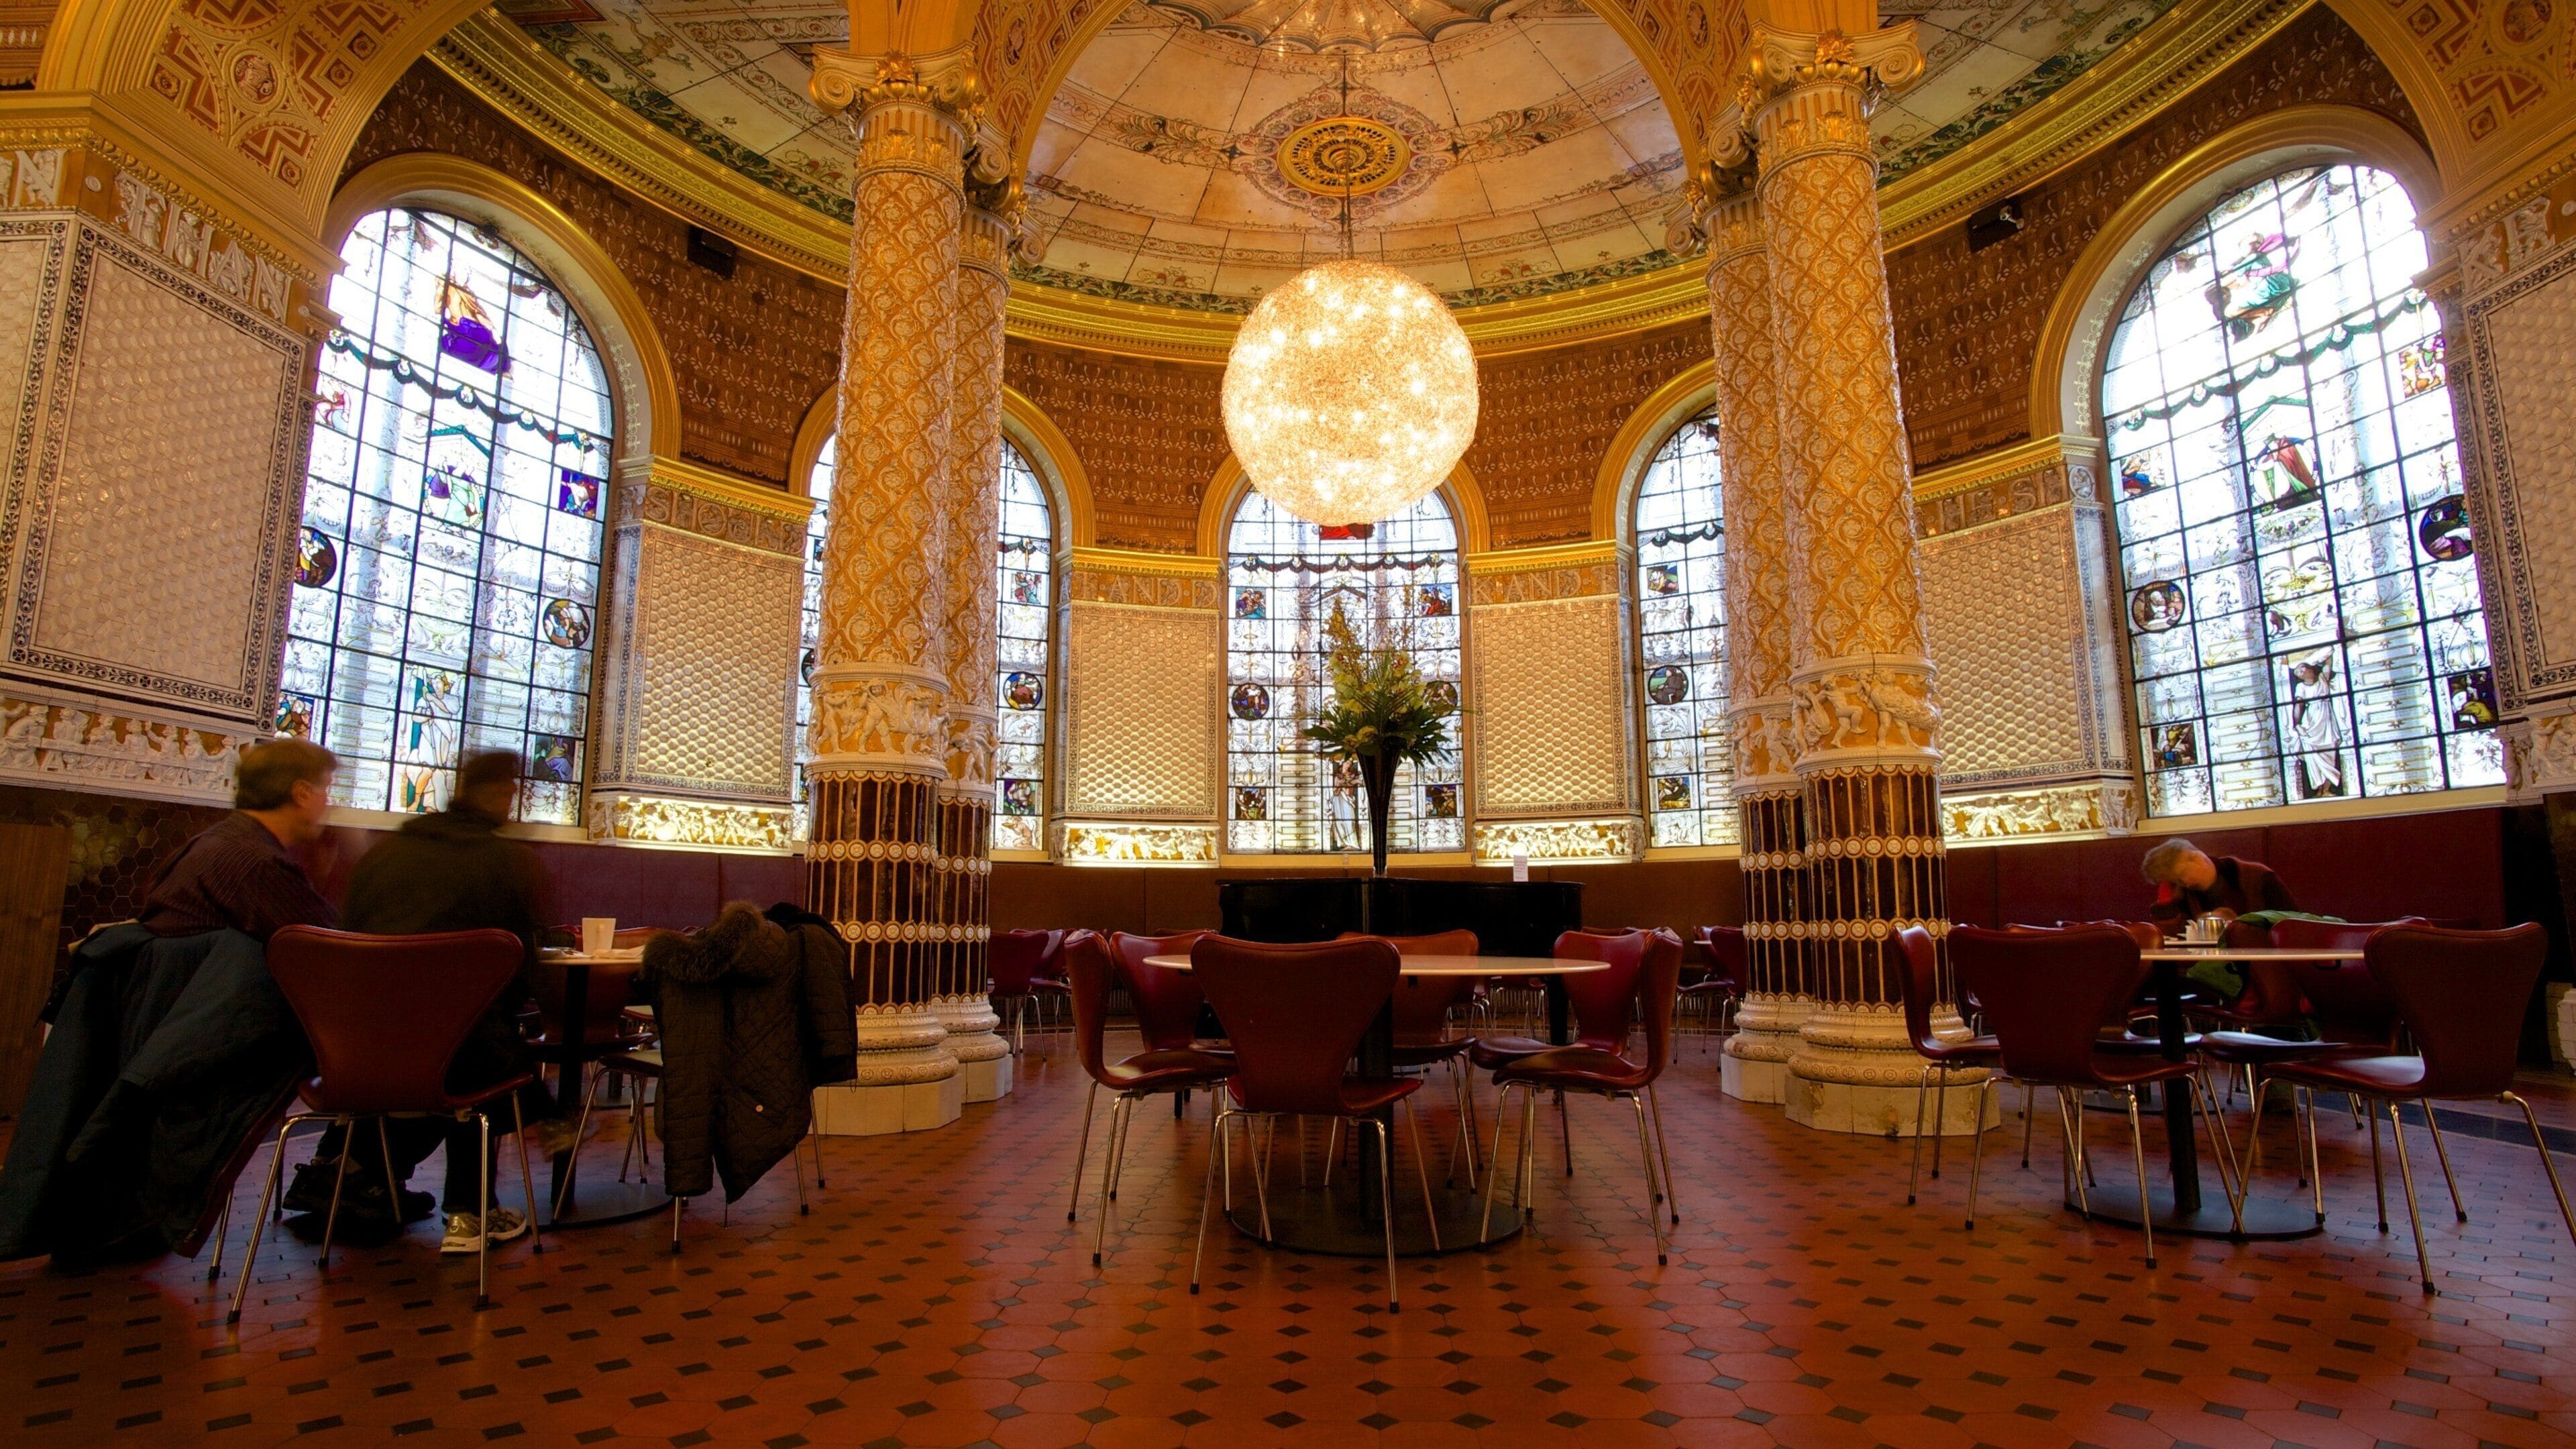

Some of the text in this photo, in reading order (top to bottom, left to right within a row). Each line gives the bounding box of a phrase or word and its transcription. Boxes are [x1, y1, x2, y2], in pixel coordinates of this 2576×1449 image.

[115, 170, 294, 325] THAN
[644, 486, 806, 554] SHOULD
[1108, 574, 1183, 606] AND
[1505, 570, 1582, 603] AND
